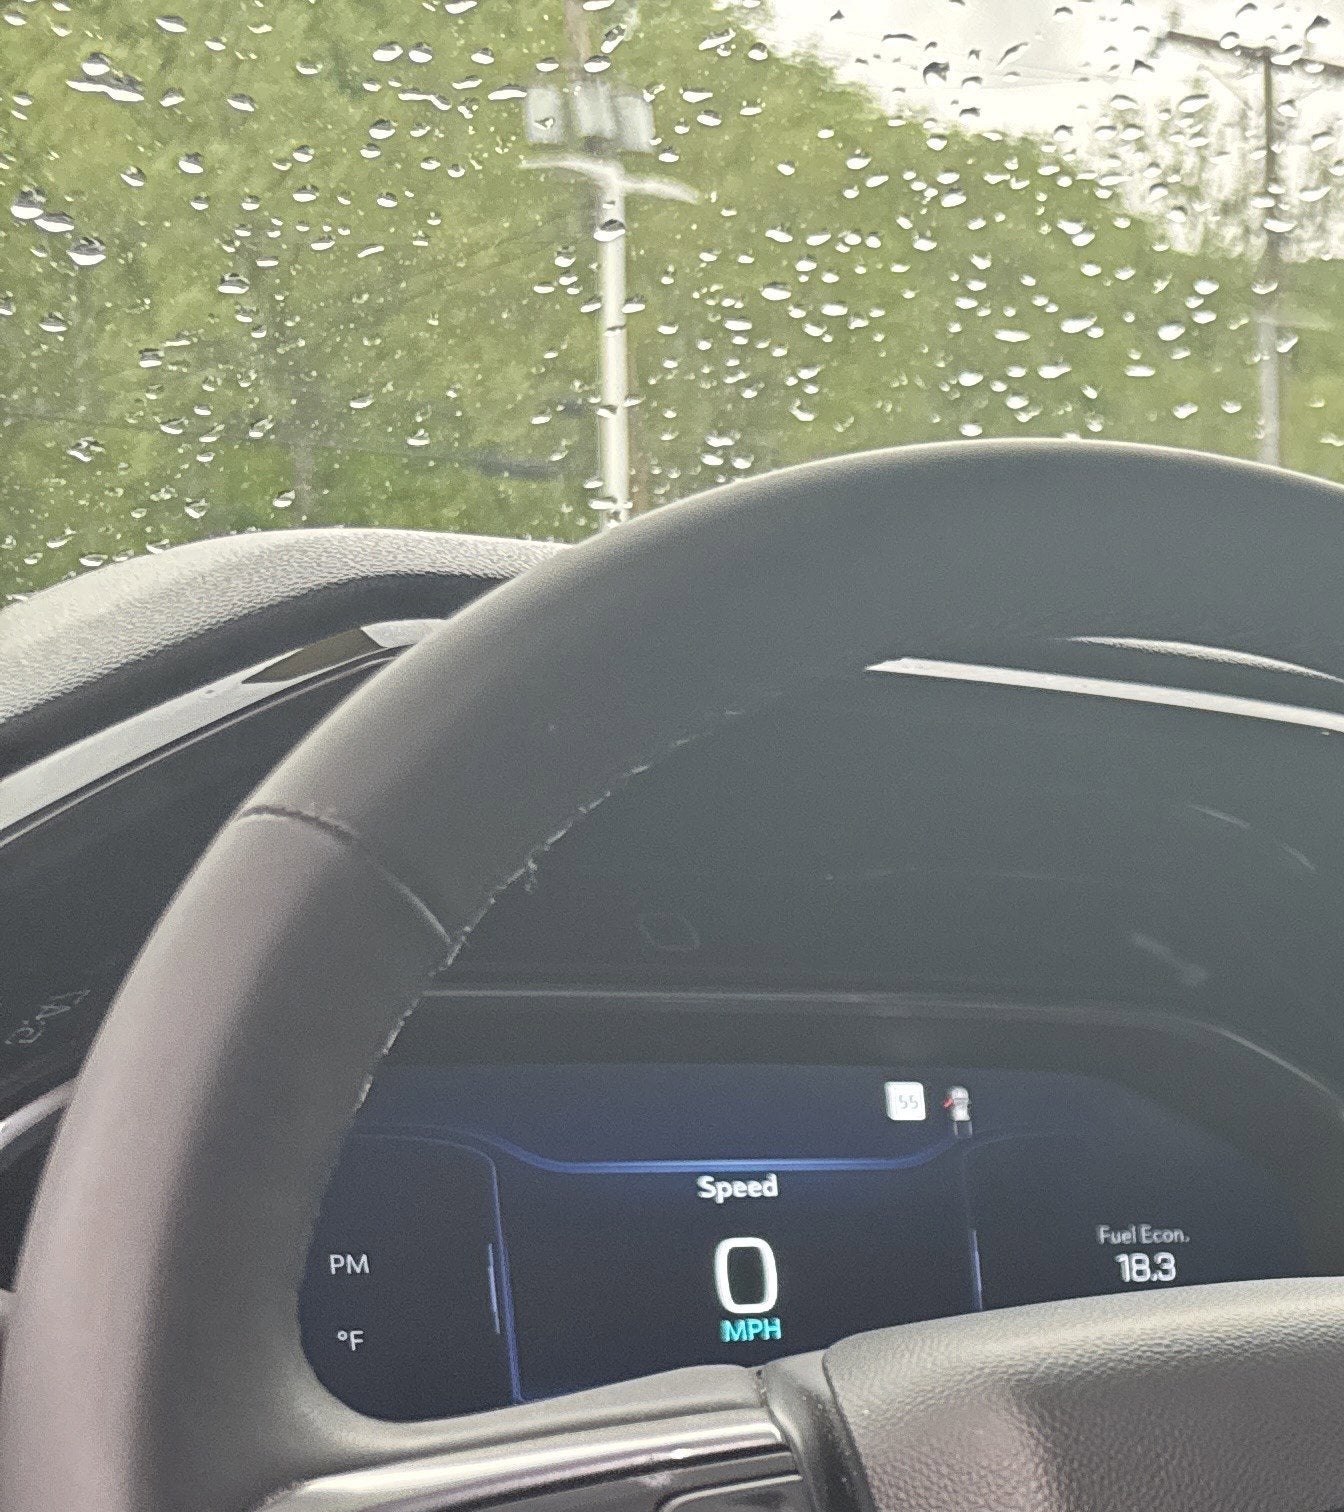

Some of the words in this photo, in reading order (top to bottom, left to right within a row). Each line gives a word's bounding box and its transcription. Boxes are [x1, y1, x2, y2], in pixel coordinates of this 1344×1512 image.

[898, 1094, 919, 1110] 55
[696, 1173, 779, 1204] Speed
[1097, 1224, 1137, 1246] Fuel
[1140, 1224, 1190, 1245] Econ.
[329, 1253, 370, 1276] PM
[714, 1236, 778, 1314] 0
[1115, 1251, 1177, 1283] 18.3
[720, 1317, 782, 1342] MPH
